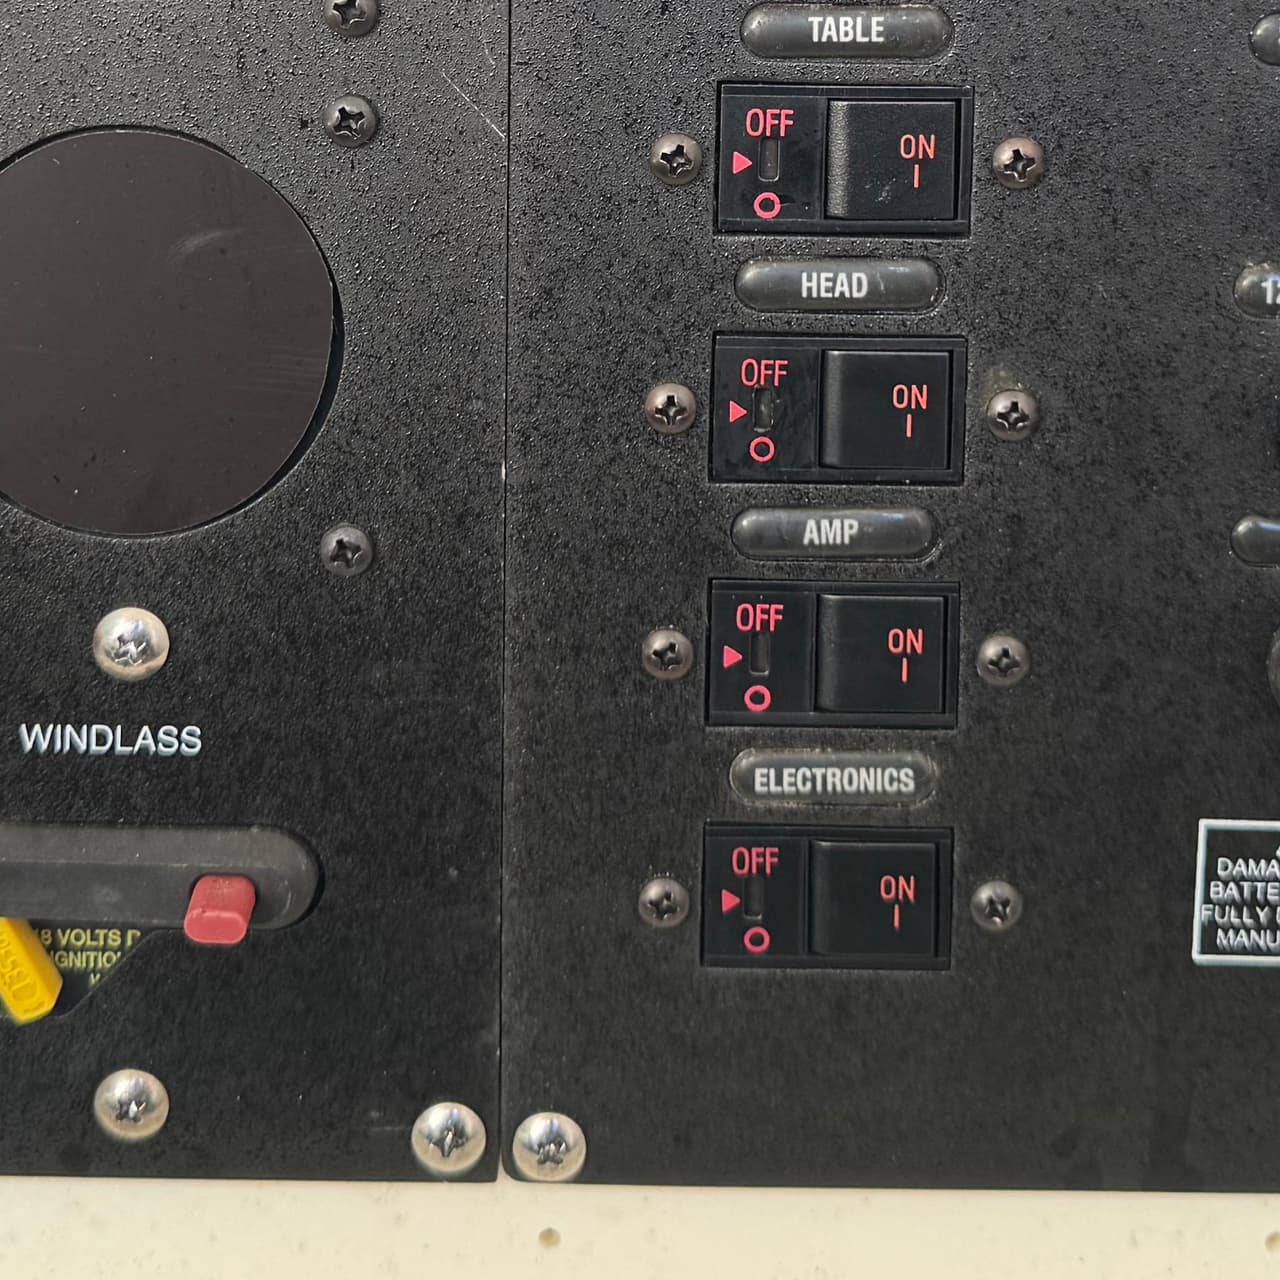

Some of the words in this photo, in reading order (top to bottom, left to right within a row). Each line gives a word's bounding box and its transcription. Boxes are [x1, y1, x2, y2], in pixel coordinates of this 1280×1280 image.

[807, 15, 886, 44] TABLE
[745, 108, 795, 138] OFF
[899, 133, 937, 161] ON
[800, 272, 869, 300] HEAD
[740, 358, 790, 388] OFF
[891, 383, 929, 411] ON
[802, 518, 860, 546] AMP
[735, 603, 785, 632] OFF
[887, 627, 925, 656] ON
[19, 722, 203, 758] WINDLASS
[752, 766, 917, 796] ELECTRONICS
[731, 847, 780, 876] OFF
[880, 875, 917, 903] ON
[1200, 903, 1269, 927] FULLY
[36, 928, 52, 946] 8
[57, 927, 122, 947] VOLTS
